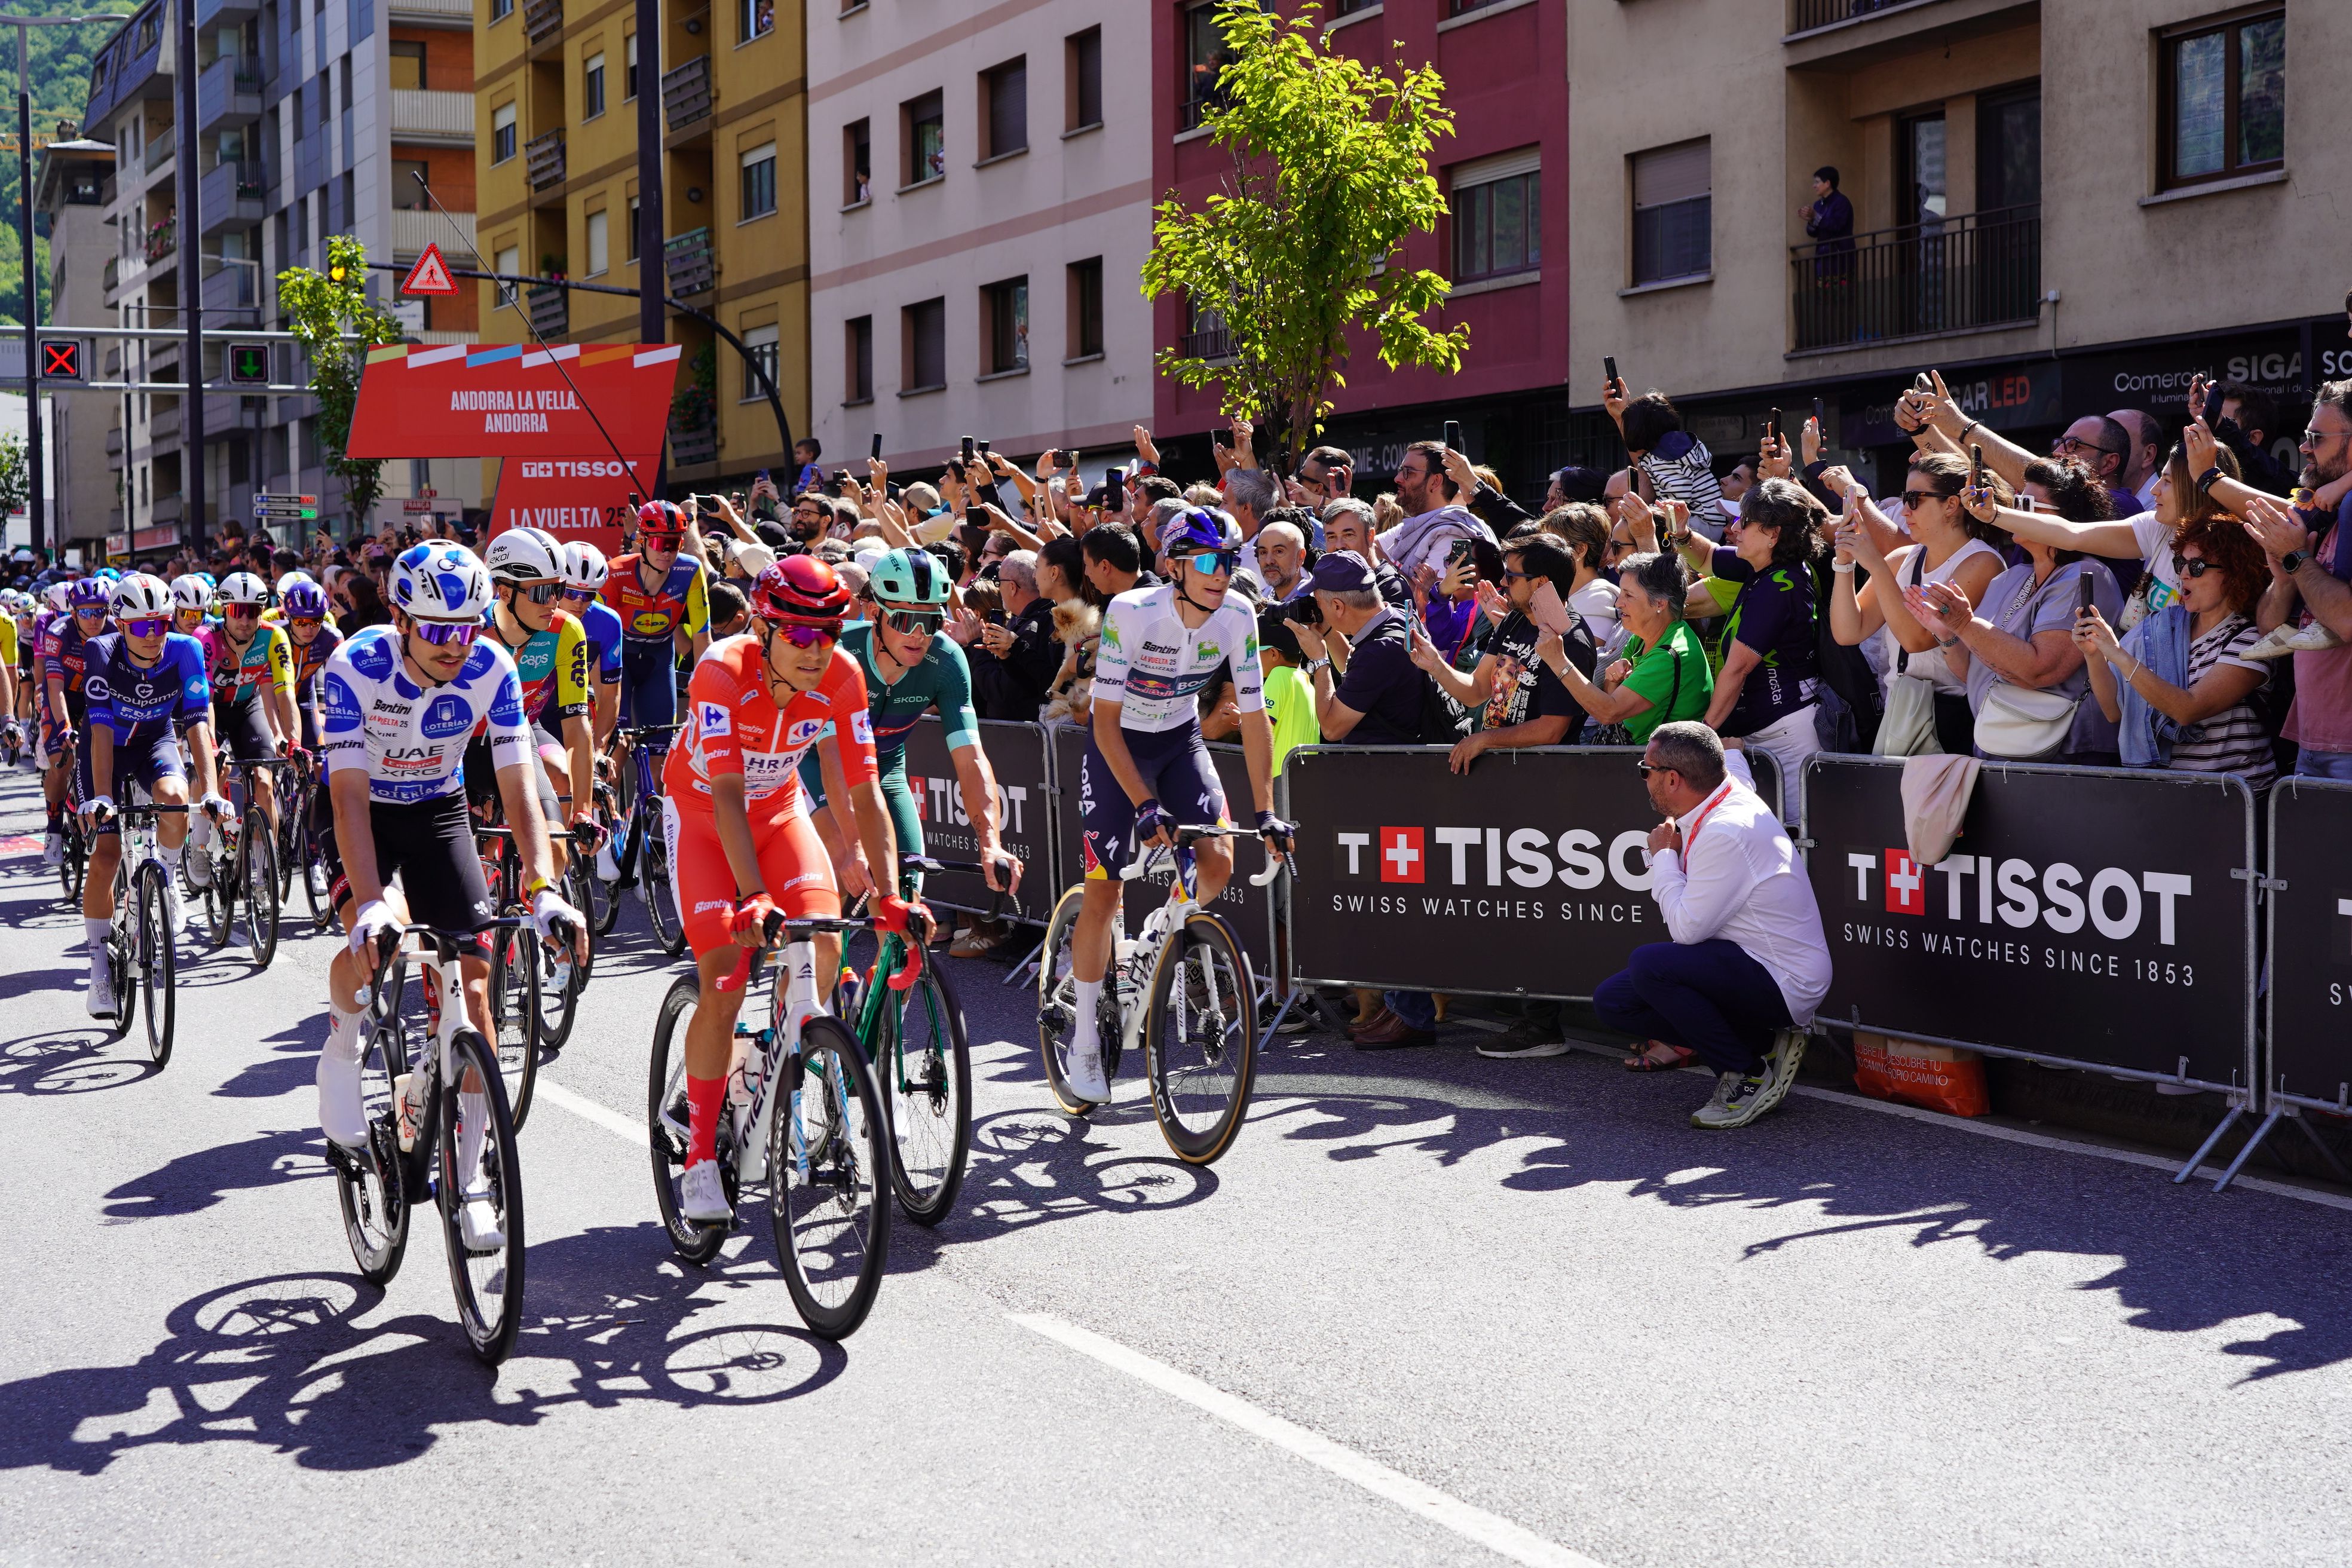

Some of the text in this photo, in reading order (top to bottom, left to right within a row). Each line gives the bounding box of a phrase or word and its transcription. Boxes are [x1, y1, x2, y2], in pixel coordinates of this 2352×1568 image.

[1991, 375, 2031, 409] LED
[451, 390, 580, 411] ANDORRA LA VELLA.
[485, 413, 548, 433] ANDORRA
[555, 461, 637, 477] TISSOT
[510, 507, 625, 528] LA VUELTA 25
[611, 570, 632, 578] TREK
[418, 568, 436, 601] MET
[662, 593, 683, 604] SRAM
[850, 647, 862, 656] ODA
[1142, 641, 1181, 655] Santini
[244, 653, 265, 666] caps
[358, 656, 387, 667] LOTERÍAS
[465, 658, 483, 670] ERÍAS
[519, 653, 549, 669] caps
[923, 653, 939, 666] KODA
[1098, 653, 1128, 665] enitude
[1149, 656, 1168, 665] VUELTA
[867, 690, 880, 699] tini
[1126, 681, 1148, 694] Red
[1149, 687, 1175, 697] Bull
[109, 688, 178, 708] Groupama
[373, 699, 412, 715] Santini
[425, 718, 468, 731] LOTERÍAS
[700, 727, 727, 737] arrefour
[385, 745, 445, 760] UAE
[380, 767, 442, 777] XRG
[388, 759, 437, 770] Emirates
[1081, 754, 1097, 816] BORA
[929, 777, 1027, 834] TISOT
[926, 831, 1030, 859] WATCHES 1853
[1338, 827, 1653, 892] T TISSO
[783, 872, 823, 892] Santini
[1848, 853, 2192, 946] T TISSOT
[1333, 895, 1643, 923] SWISS WATCHES SINCE
[1843, 922, 2194, 987] SWISS WATCHES SINCE 1853
[1886, 1054, 1942, 1071] DESCUBRE TU
[1888, 1068, 1949, 1086] ROPIO CAMINO
